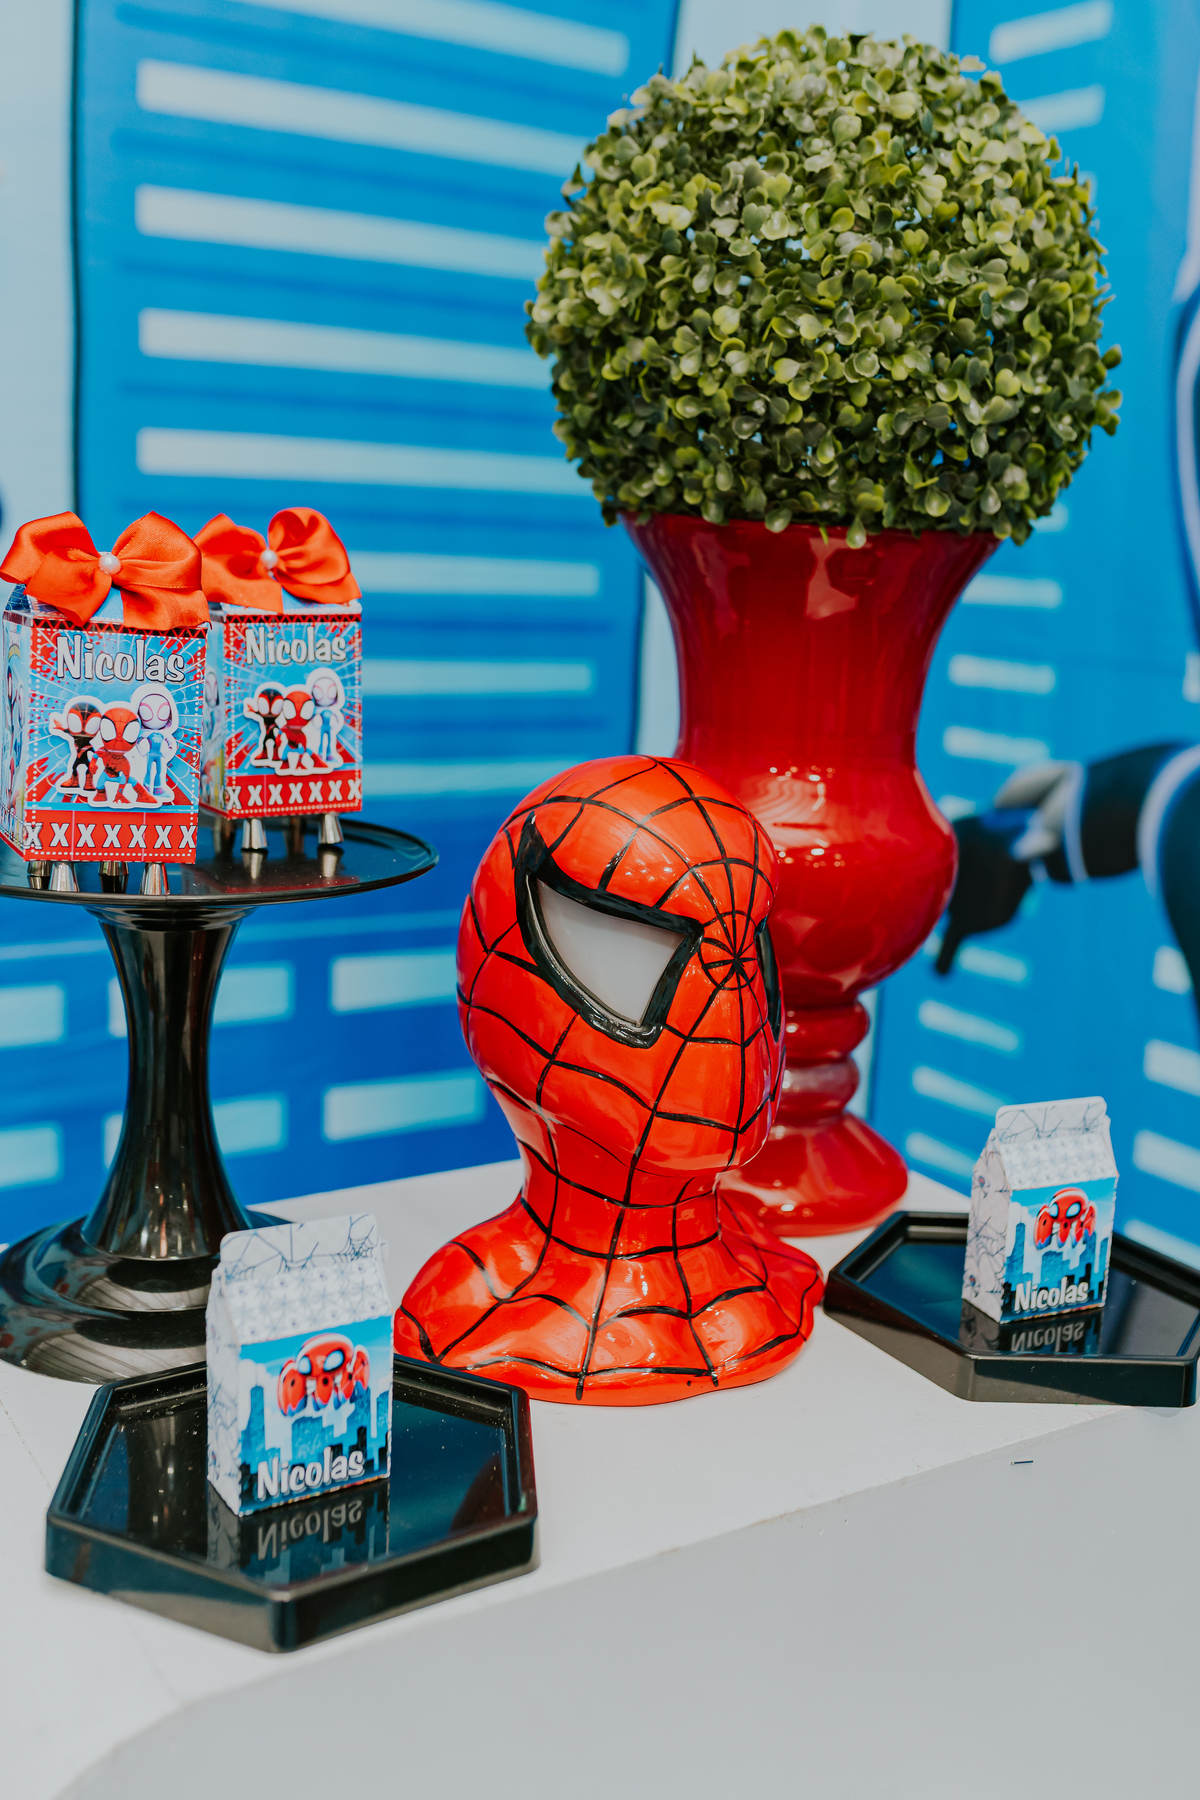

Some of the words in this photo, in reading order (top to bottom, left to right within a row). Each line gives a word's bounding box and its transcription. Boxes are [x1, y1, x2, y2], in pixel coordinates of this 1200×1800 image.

[56, 634, 186, 682] Nicolas
[245, 626, 347, 666] Nicolas
[1014, 1276, 1089, 1313] Nicolas
[256, 1446, 365, 1501] Nicolas
